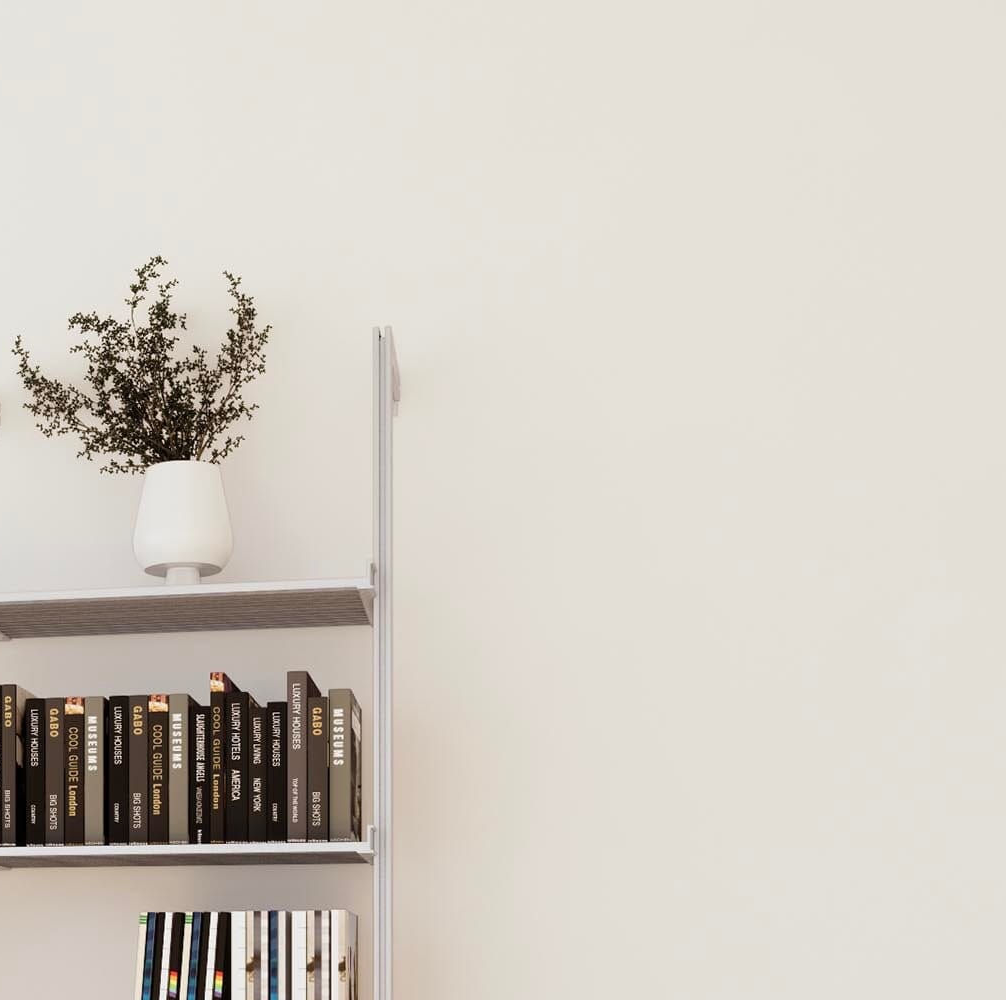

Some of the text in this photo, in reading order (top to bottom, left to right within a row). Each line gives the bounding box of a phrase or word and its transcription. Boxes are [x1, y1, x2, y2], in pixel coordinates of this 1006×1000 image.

[30, 709, 38, 735] LUXURY
[50, 709, 59, 737] GABO
[88, 716, 97, 771] MUSEUMS
[114, 707, 122, 764] LUXURY HOUSES
[133, 706, 142, 735] GABO
[172, 713, 182, 769] MUSEUMS
[196, 714, 205, 760] SLAUGHTERHOUSE
[272, 712, 280, 766] LUXURY HOUSES
[293, 717, 301, 749] HOUSES
[312, 707, 322, 736] GABO
[333, 709, 344, 766] MUSEUMS
[69, 727, 78, 816] COOL GUIDE London
[153, 725, 162, 815] COOL GUIDE London
[196, 762, 205, 782] ANGELS
[231, 703, 240, 801] LUXURY HOTELS AMERICA
[253, 718, 261, 812] LUXURY LIVING NEW YORK
[133, 793, 141, 828] BIG SHOTS
[313, 804, 321, 826] SHOTS
